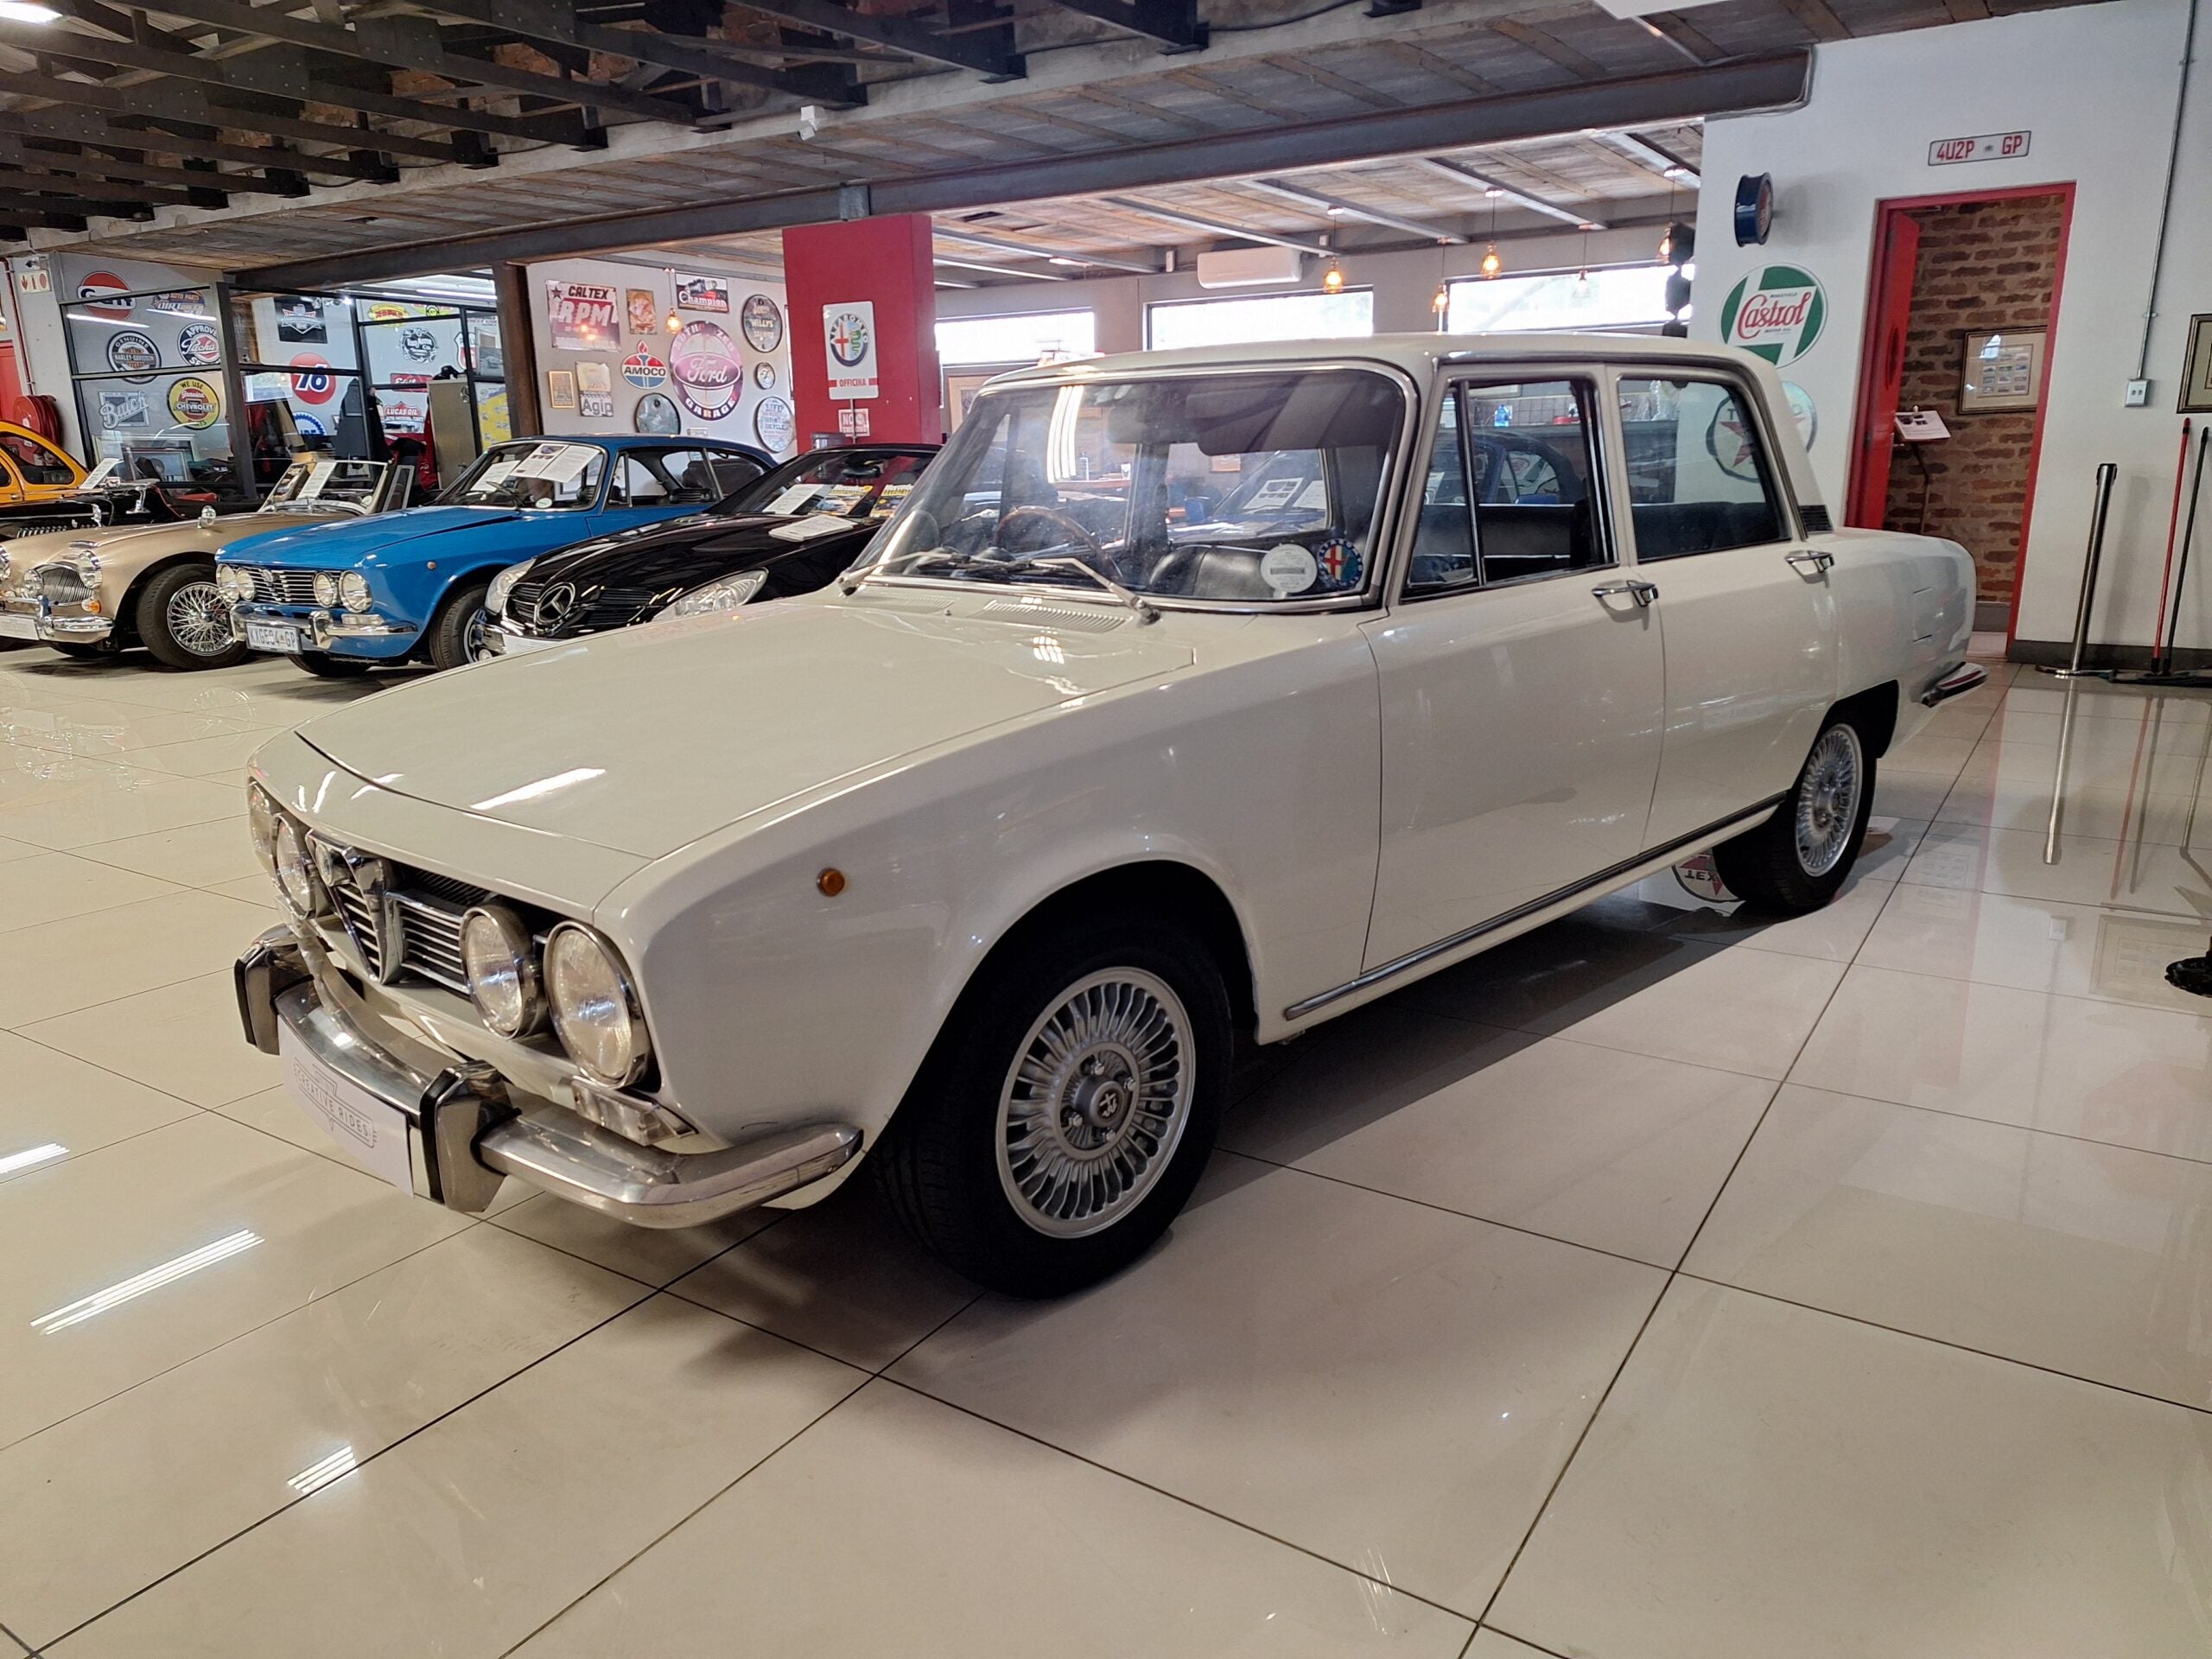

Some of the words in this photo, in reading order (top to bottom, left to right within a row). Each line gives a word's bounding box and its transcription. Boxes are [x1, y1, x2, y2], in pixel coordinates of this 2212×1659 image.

[1936, 140, 1974, 162] 4U2P
[2001, 135, 2023, 155] GP
[568, 285, 609, 300] CALTEX
[679, 289, 727, 307] Champion
[558, 301, 612, 327] RPM
[1738, 291, 1812, 339] Castrol
[115, 336, 149, 347] GENUINE
[186, 325, 219, 338] APPROVE
[181, 338, 217, 354] Packa
[296, 364, 329, 392] 76
[624, 365, 666, 377] AMOCO
[687, 357, 728, 383] Ford
[839, 378, 867, 387] OFFICINA
[100, 391, 149, 429] Buick
[582, 398, 613, 416] Agip
[685, 393, 737, 417] GARAGE
[297, 1070, 334, 1113] CREATIVE
[339, 1107, 368, 1137] RIDES
